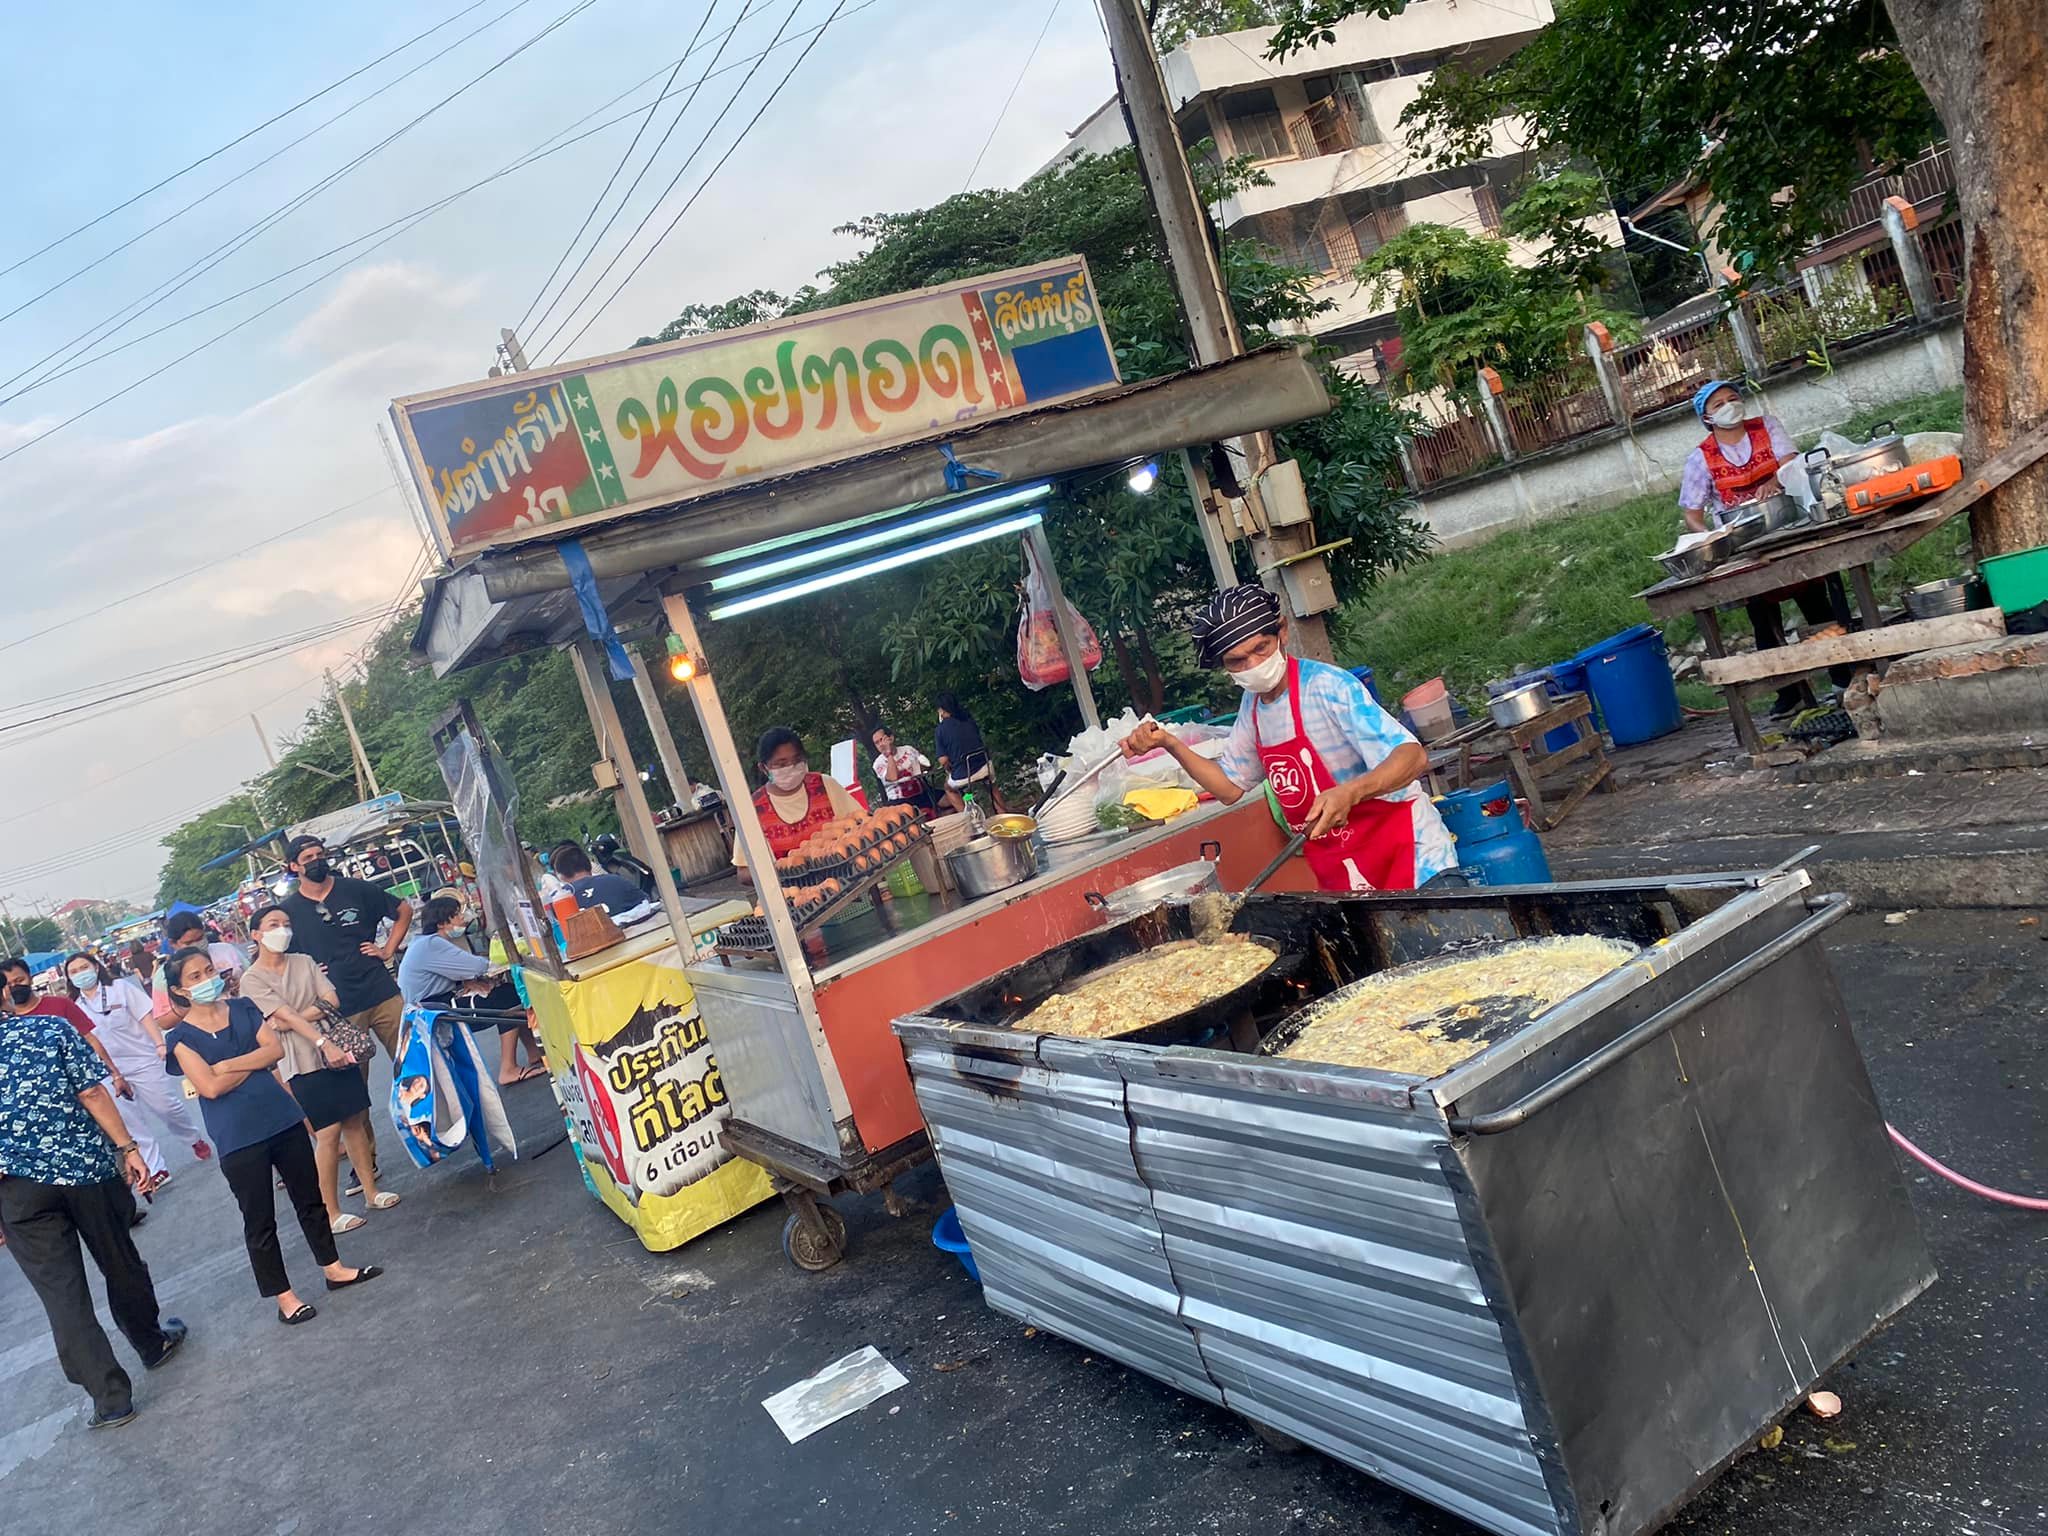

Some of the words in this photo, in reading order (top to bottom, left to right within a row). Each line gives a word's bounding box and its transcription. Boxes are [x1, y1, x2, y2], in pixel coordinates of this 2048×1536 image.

[994, 271, 1092, 340] สิงห์บุรี
[616, 324, 984, 480] หอยทอด
[647, 1162, 658, 1181] 6
[664, 1130, 715, 1170] เดือน
